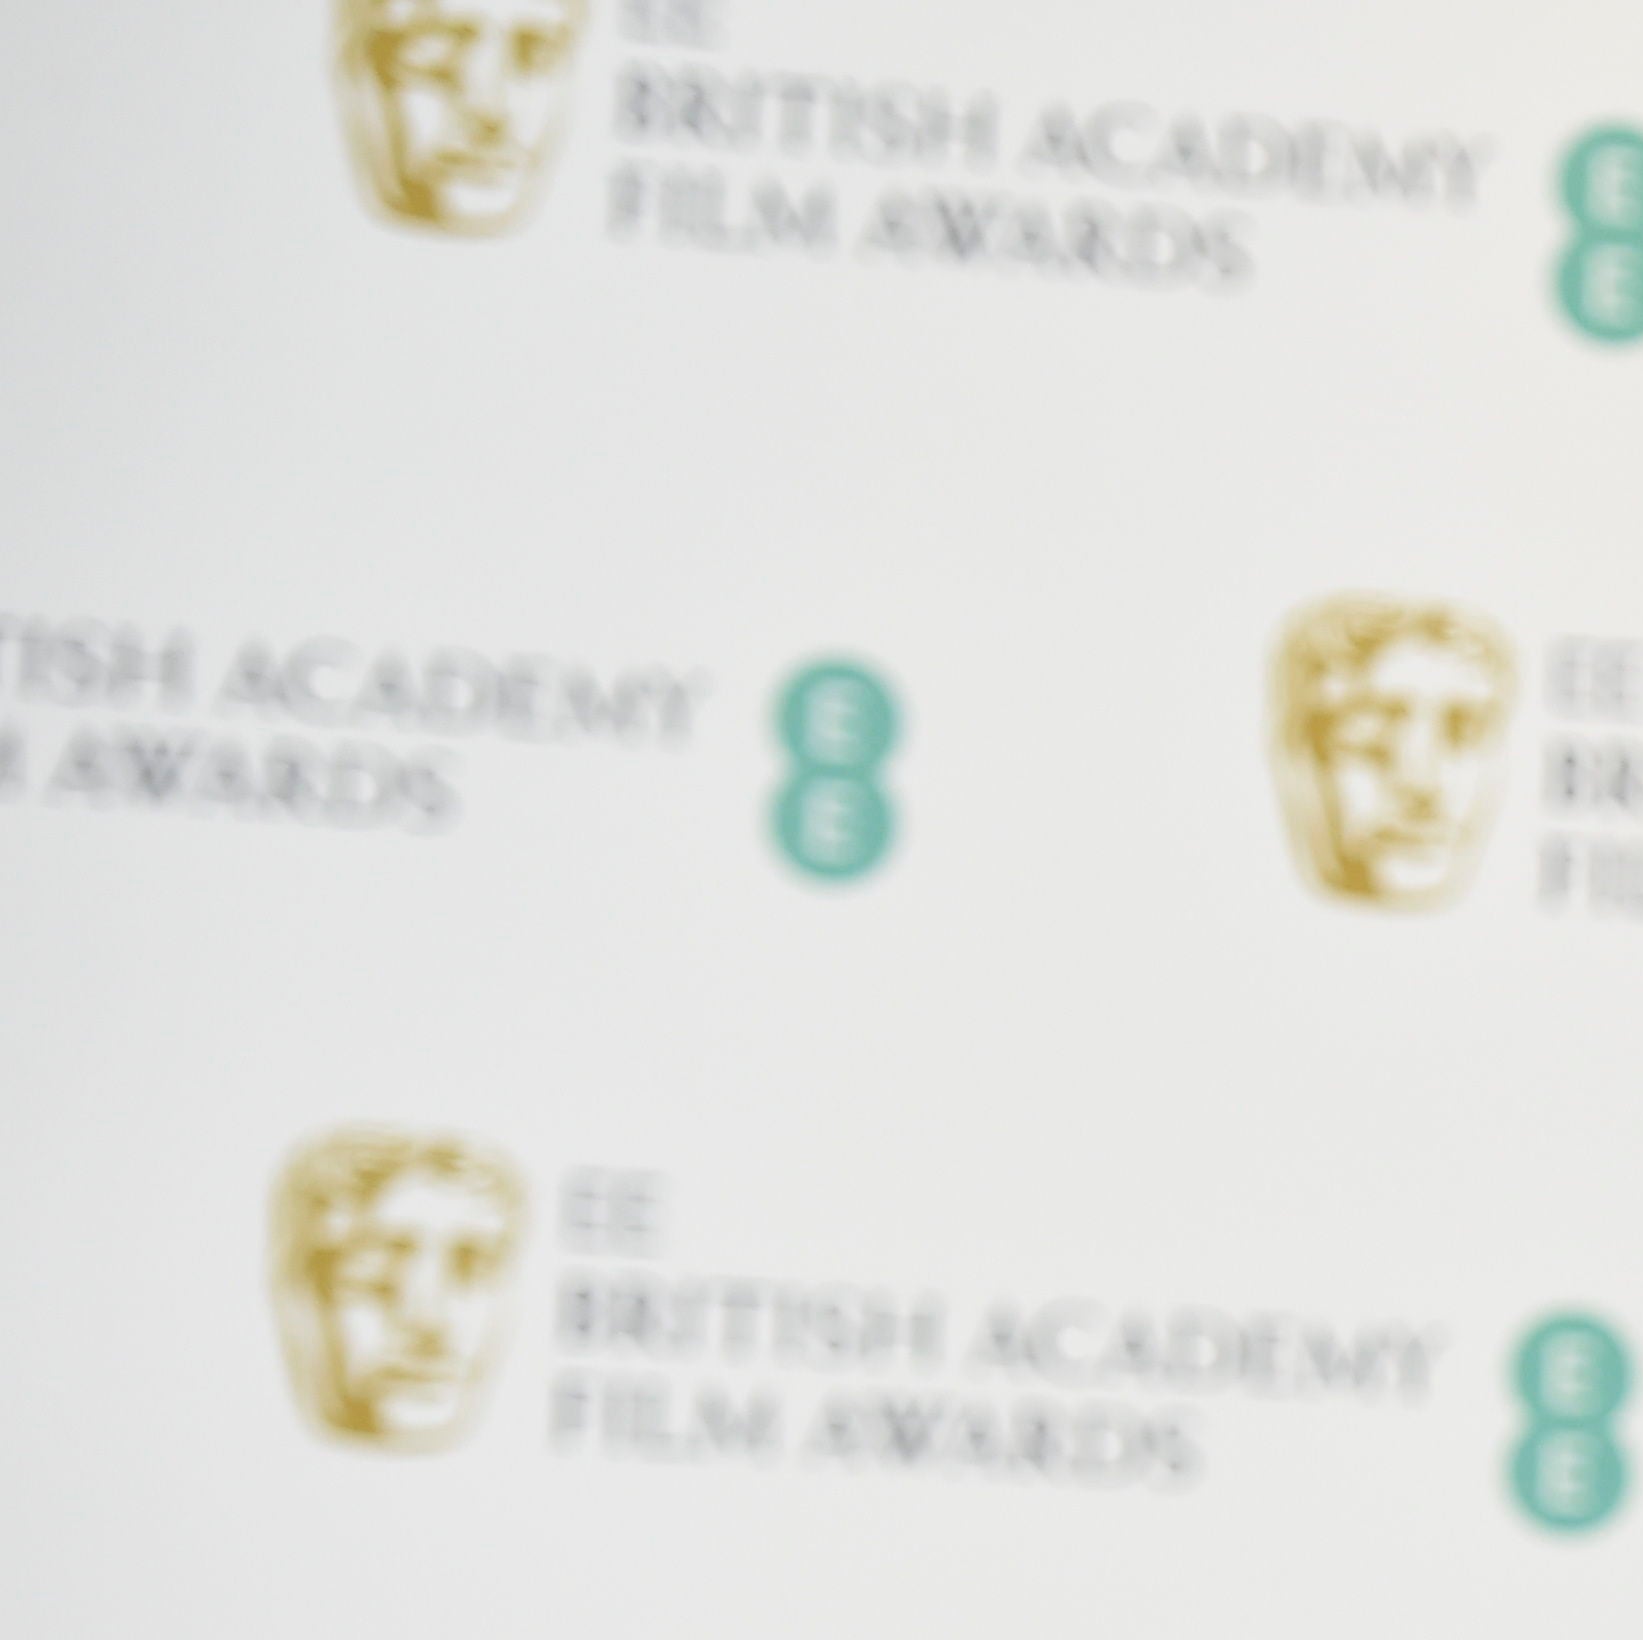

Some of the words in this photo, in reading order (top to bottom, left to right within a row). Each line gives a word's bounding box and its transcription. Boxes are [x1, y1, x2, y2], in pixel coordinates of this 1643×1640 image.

[618, 63, 1000, 168] BRITISH
[1021, 96, 1493, 205] ACADEMY
[607, 165, 838, 254] FILM
[858, 188, 1254, 293] AWARDS
[213, 642, 709, 750] ACADEMY
[46, 729, 462, 835] AWARDS
[555, 1270, 943, 1373] BRITISH
[967, 1296, 1451, 1400] ACADEMY
[549, 1370, 778, 1461] FILM
[799, 1390, 1205, 1492] AWARDS
